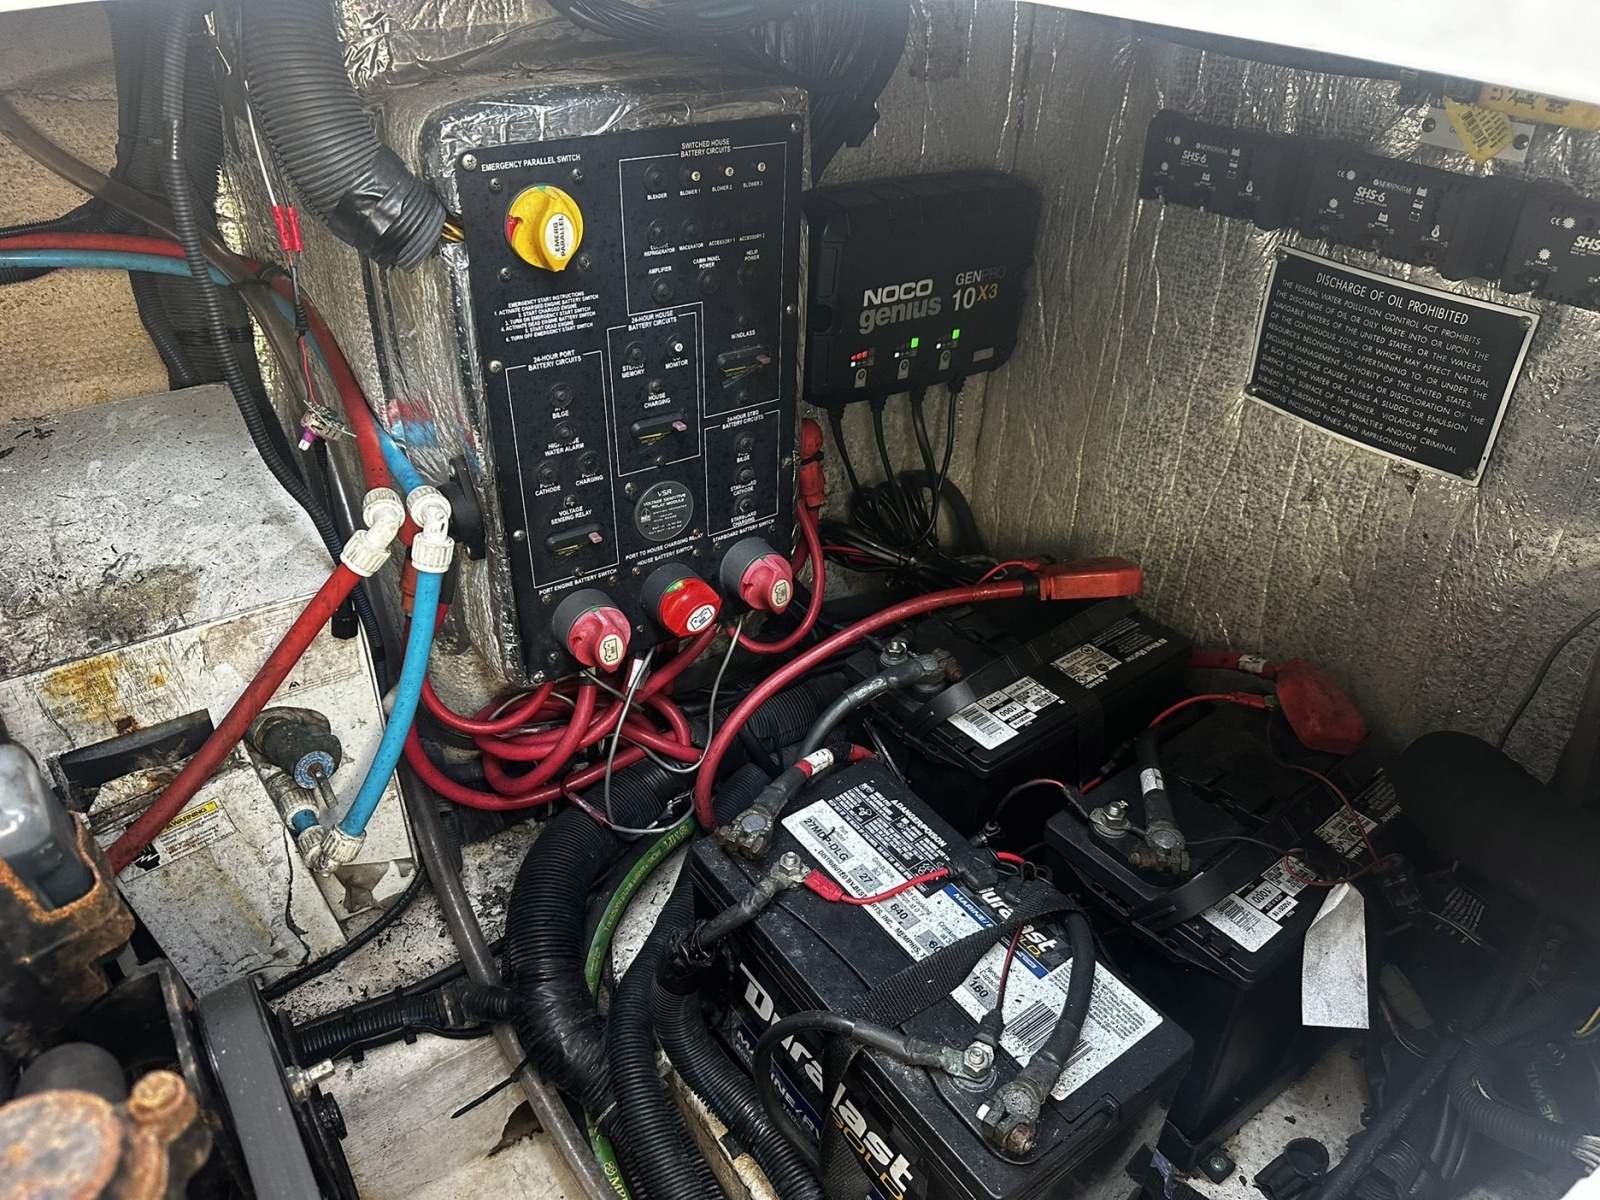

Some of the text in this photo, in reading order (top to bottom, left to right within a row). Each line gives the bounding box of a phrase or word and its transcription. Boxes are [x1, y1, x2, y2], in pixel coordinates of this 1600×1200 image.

[680, 145, 730, 158] BATTERY CIRCUITS
[681, 137, 729, 150] SWITCHED HOUSE
[481, 153, 580, 172] EMERGENCY PARALLEL SWITCH
[1355, 186, 1386, 202] SHS-6
[1573, 235, 1600, 251] SHS
[863, 279, 933, 307] NOCO
[1315, 271, 1469, 326] DISCHARGE OF OIL PROHIBITED
[655, 310, 673, 319] HOUSE
[859, 296, 941, 334] genius
[1281, 279, 1482, 346] THE FEDERAL WATER POLLUTION CONTROL ACT PROHIBITS
[628, 316, 676, 331] BATTERY CIRCUITS
[1275, 289, 1490, 361] THE DISCHARGE OF OIL OR OILY WASTE INTO OR UPON THE
[731, 329, 755, 340] WINDLASS
[1272, 299, 1304, 318] NAVIGABLE
[1305, 312, 1330, 327] WATERS
[1331, 320, 1342, 331] OF
[1344, 325, 1358, 336] THE
[1359, 329, 1386, 345] UNITED
[1416, 347, 1429, 358] OR
[1431, 352, 1447, 363] THE
[1449, 357, 1482, 373] WATERS
[559, 349, 575, 357] PORT
[1269, 310, 1279, 320] OF
[1280, 315, 1292, 325] THE
[1293, 319, 1336, 341] CONTIGUOUS
[1361, 342, 1373, 353] OR
[1374, 347, 1401, 362] WHICH
[1402, 356, 1421, 368] MAY
[1422, 362, 1451, 377] AFFECT
[1453, 371, 1490, 388] NATURAL
[528, 355, 581, 371] BATTERY CIRCUITS
[665, 358, 688, 369] MONITOR
[1265, 332, 1474, 410] EXCLUSIVE MANAGEMENT AUTHORITY OF THE UNITED STATES.
[621, 367, 645, 379] MEMORY
[644, 396, 670, 409] CHARGING
[648, 392, 665, 402] HOUSE
[552, 409, 569, 419] BILGE
[722, 413, 763, 430] BATTERY CIRCUITS
[544, 442, 584, 457] WATER ALARM
[575, 473, 603, 486] CHARGING
[534, 484, 560, 497] CATHODE
[550, 508, 591, 525] SENSING RELAY
[558, 505, 582, 517] VOLTAGE
[712, 517, 774, 543] STARBOARD BATTERY SWITCH
[625, 552, 638, 561] PORT
[647, 544, 662, 554] HOUSE
[664, 536, 687, 549] CHARGING
[637, 544, 693, 566] HOUSE BATTERY SWITCH
[539, 567, 616, 596] PORT ENGINE BATTERY SWITCH
[986, 695, 1001, 705] 130
[999, 706, 1017, 717] 1000
[170, 808, 208, 827] WARNING
[815, 849, 849, 879] DISTRIBUTED
[857, 872, 873, 884] 27
[1251, 886, 1272, 904] 1000
[888, 903, 910, 920] 640
[951, 892, 994, 928] MARINE/R
[968, 979, 990, 998] 160
